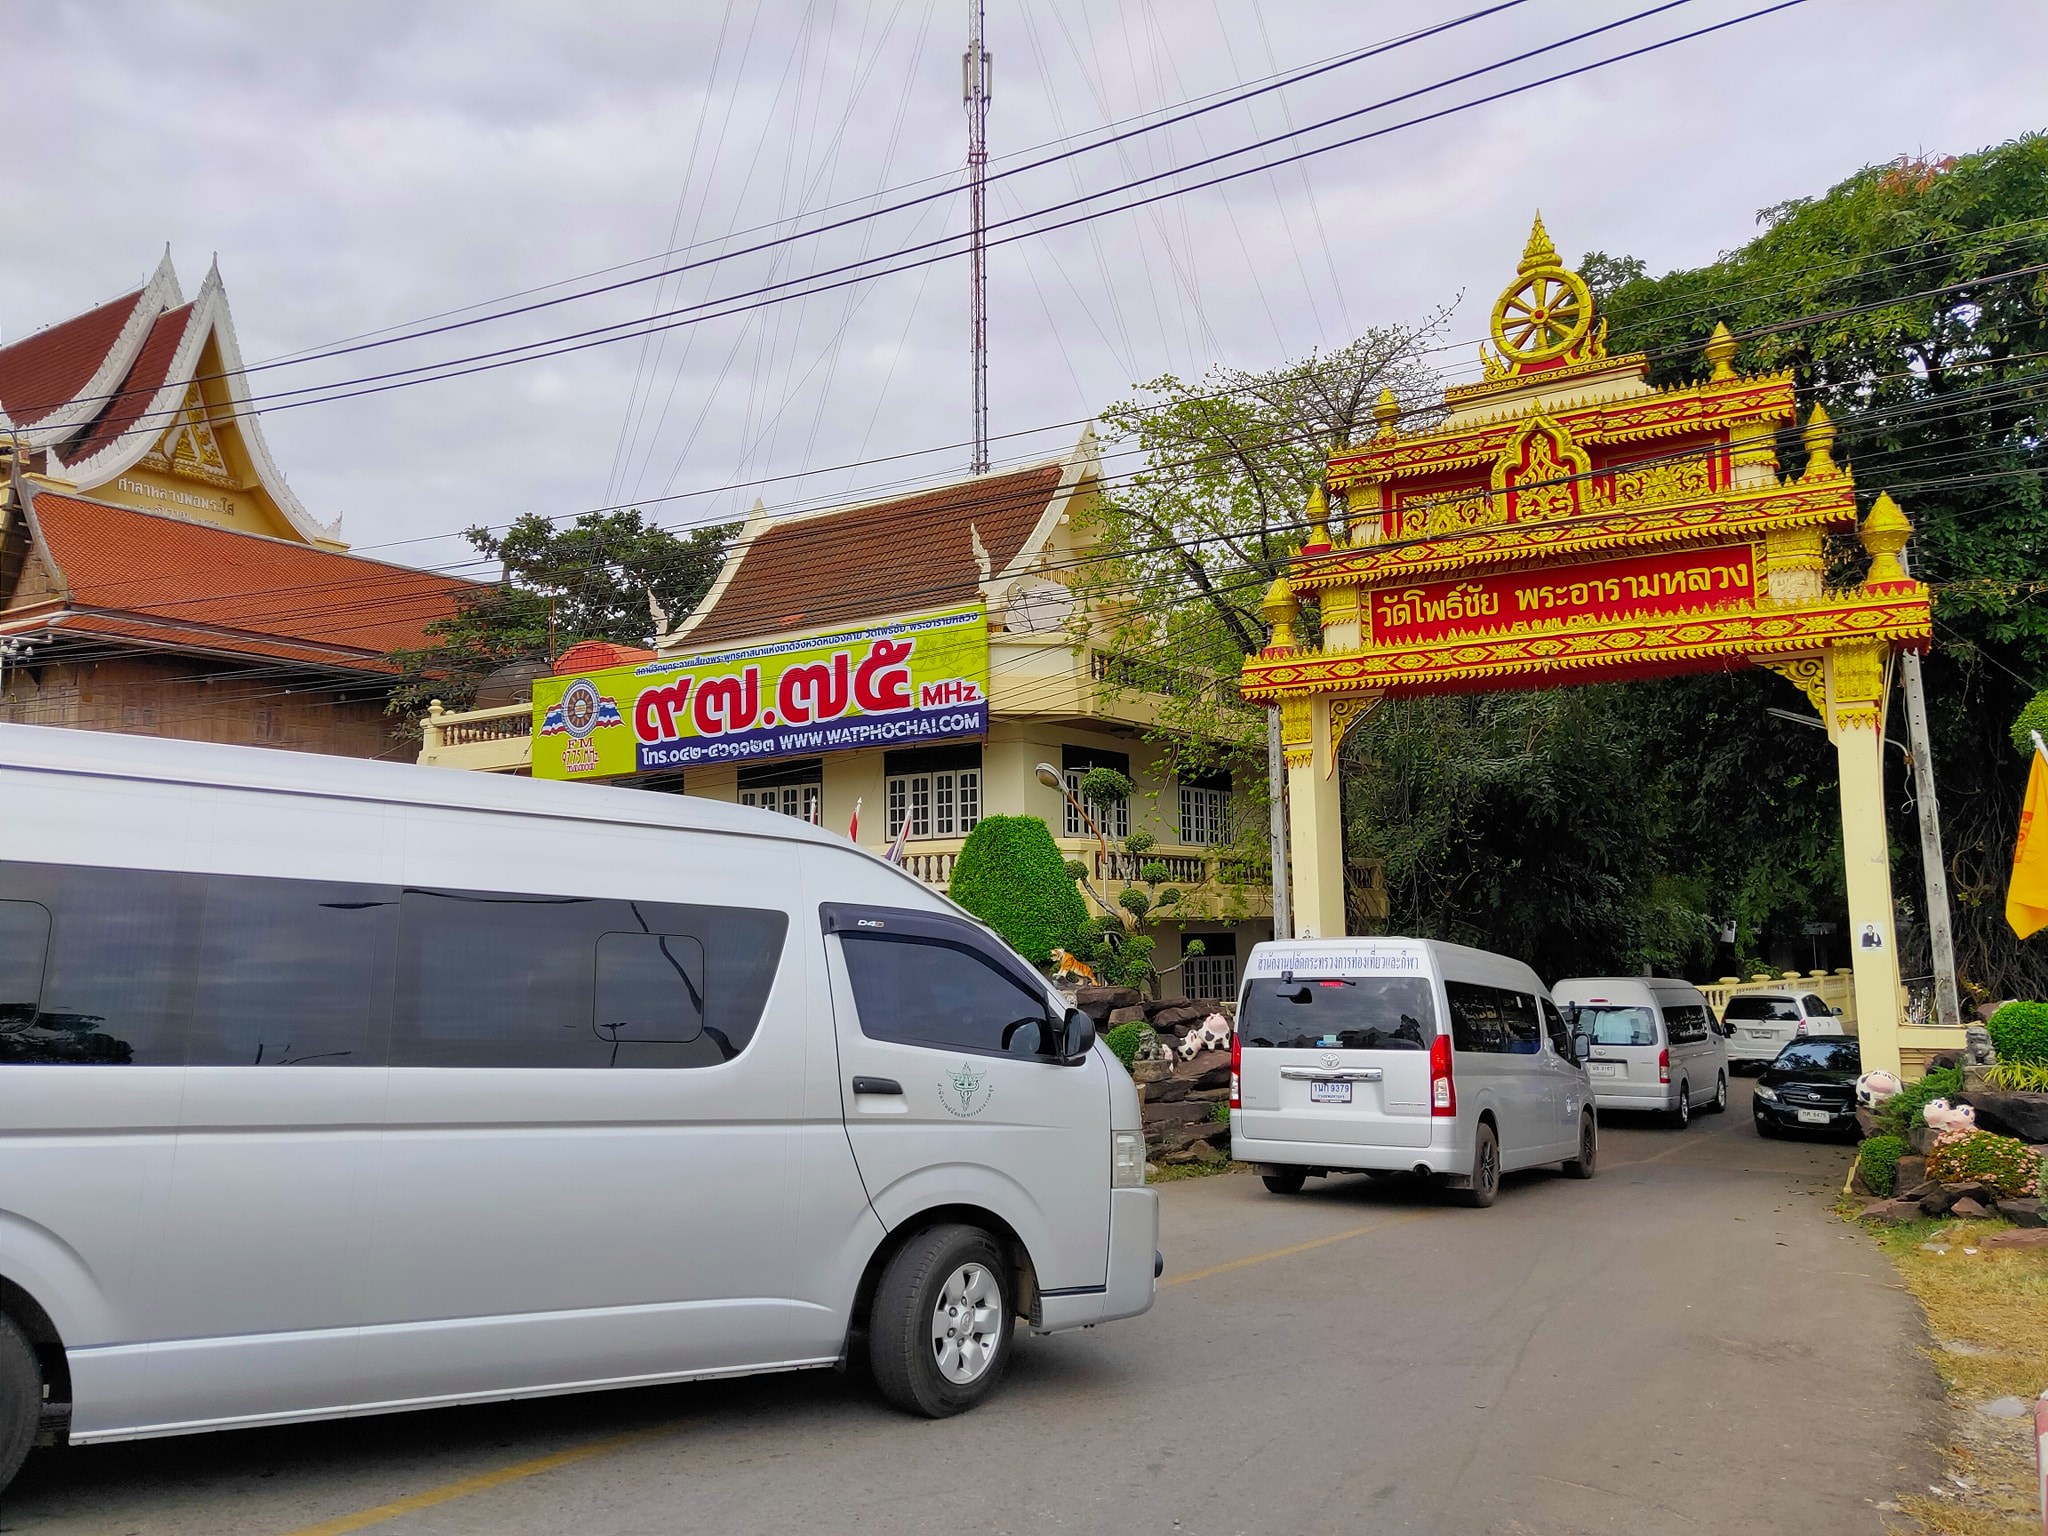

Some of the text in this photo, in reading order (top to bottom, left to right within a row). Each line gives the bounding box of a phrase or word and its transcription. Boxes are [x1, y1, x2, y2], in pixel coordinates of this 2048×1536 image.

[1376, 582, 1500, 628] วัดโพธิ์ชัย
[1514, 562, 1749, 612] พระอารามหลวง
[635, 639, 913, 742] ๙๗.๗๕
[779, 712, 980, 750] WWW.WATPHOCHAI.COM
[1330, 1084, 1350, 1093] 9379
